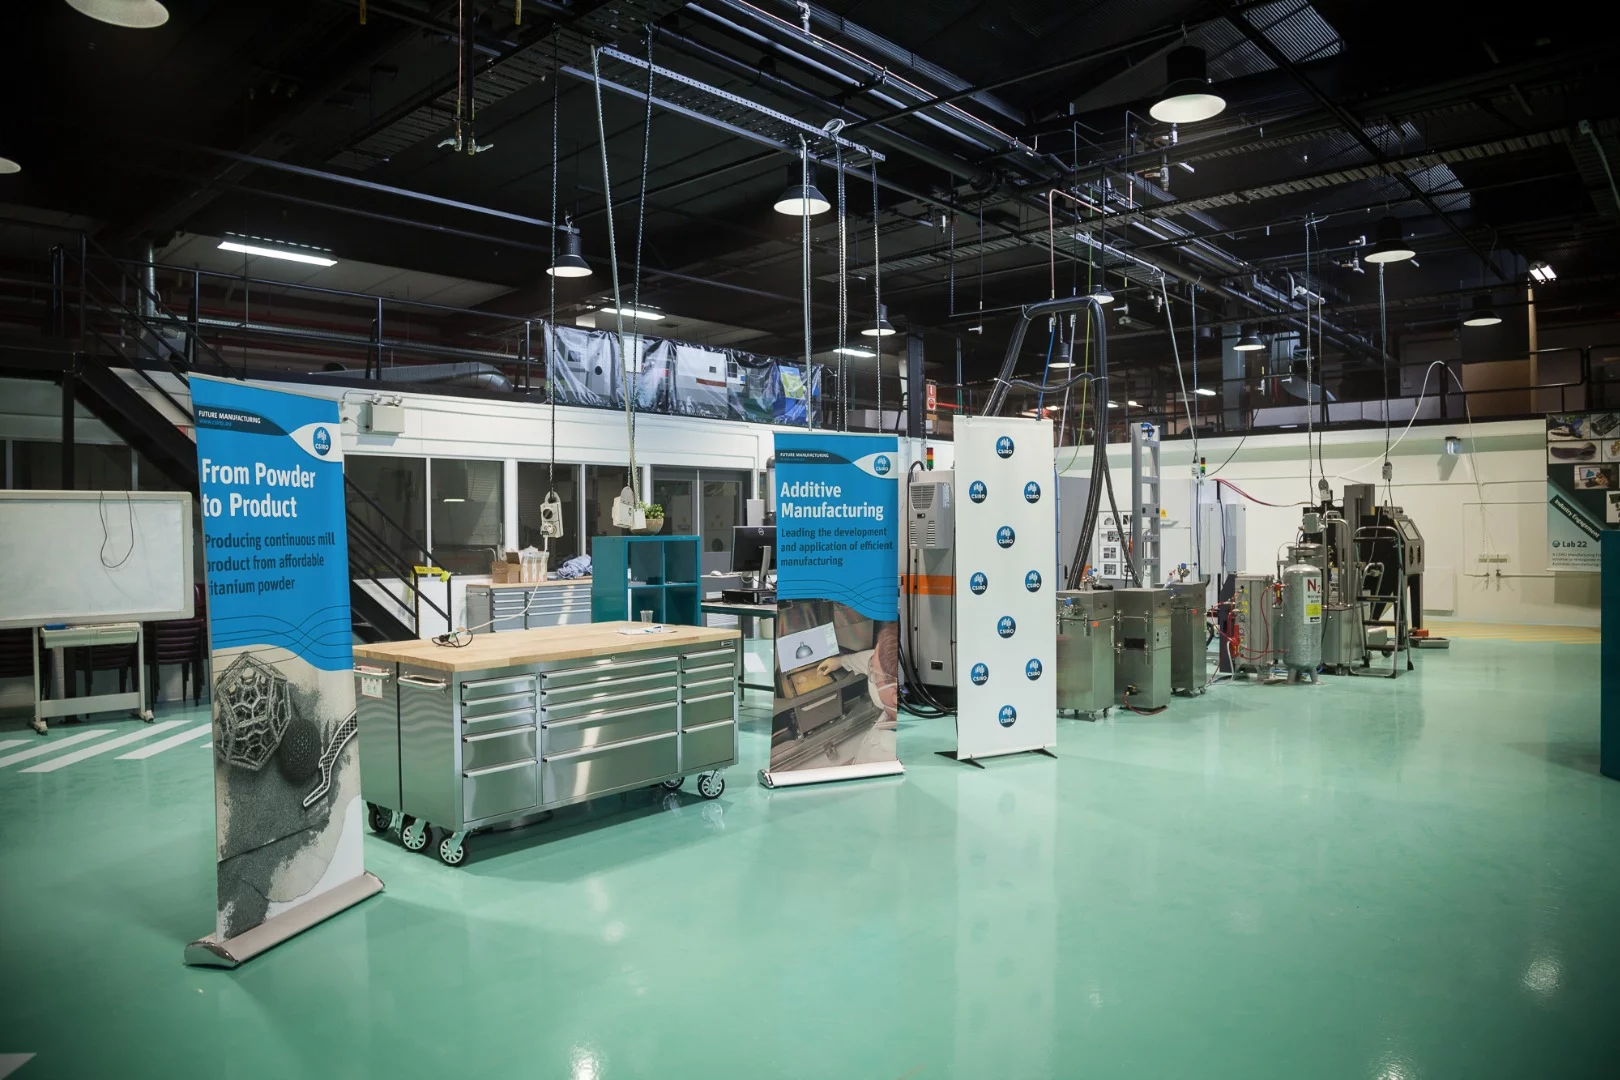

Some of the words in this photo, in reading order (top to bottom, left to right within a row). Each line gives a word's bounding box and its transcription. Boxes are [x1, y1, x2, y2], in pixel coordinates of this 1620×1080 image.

[198, 410, 218, 419] FUTURE
[218, 412, 261, 424] MANUFACTURING
[315, 443, 330, 451] CSIRO
[202, 458, 250, 485] From
[255, 462, 316, 489] Powder
[780, 481, 842, 498] Additive
[202, 493, 222, 518] to
[229, 492, 298, 518] Product
[781, 501, 884, 521] Manufacturing
[1554, 499, 1573, 516] Industry
[1572, 513, 1600, 538] Engagement
[204, 532, 262, 551] Producing
[264, 533, 316, 547] continuous
[317, 532, 335, 546] mill
[781, 528, 815, 540] Leading
[818, 527, 832, 537] the
[834, 527, 887, 539] development
[780, 542, 797, 552] and
[799, 541, 847, 554] application
[849, 541, 858, 551] of
[860, 541, 893, 551] efficient
[253, 555, 276, 570] from
[279, 552, 325, 568] affordable
[780, 556, 843, 568] manufacturing
[209, 579, 255, 596] itanium
[257, 577, 296, 595] powder
